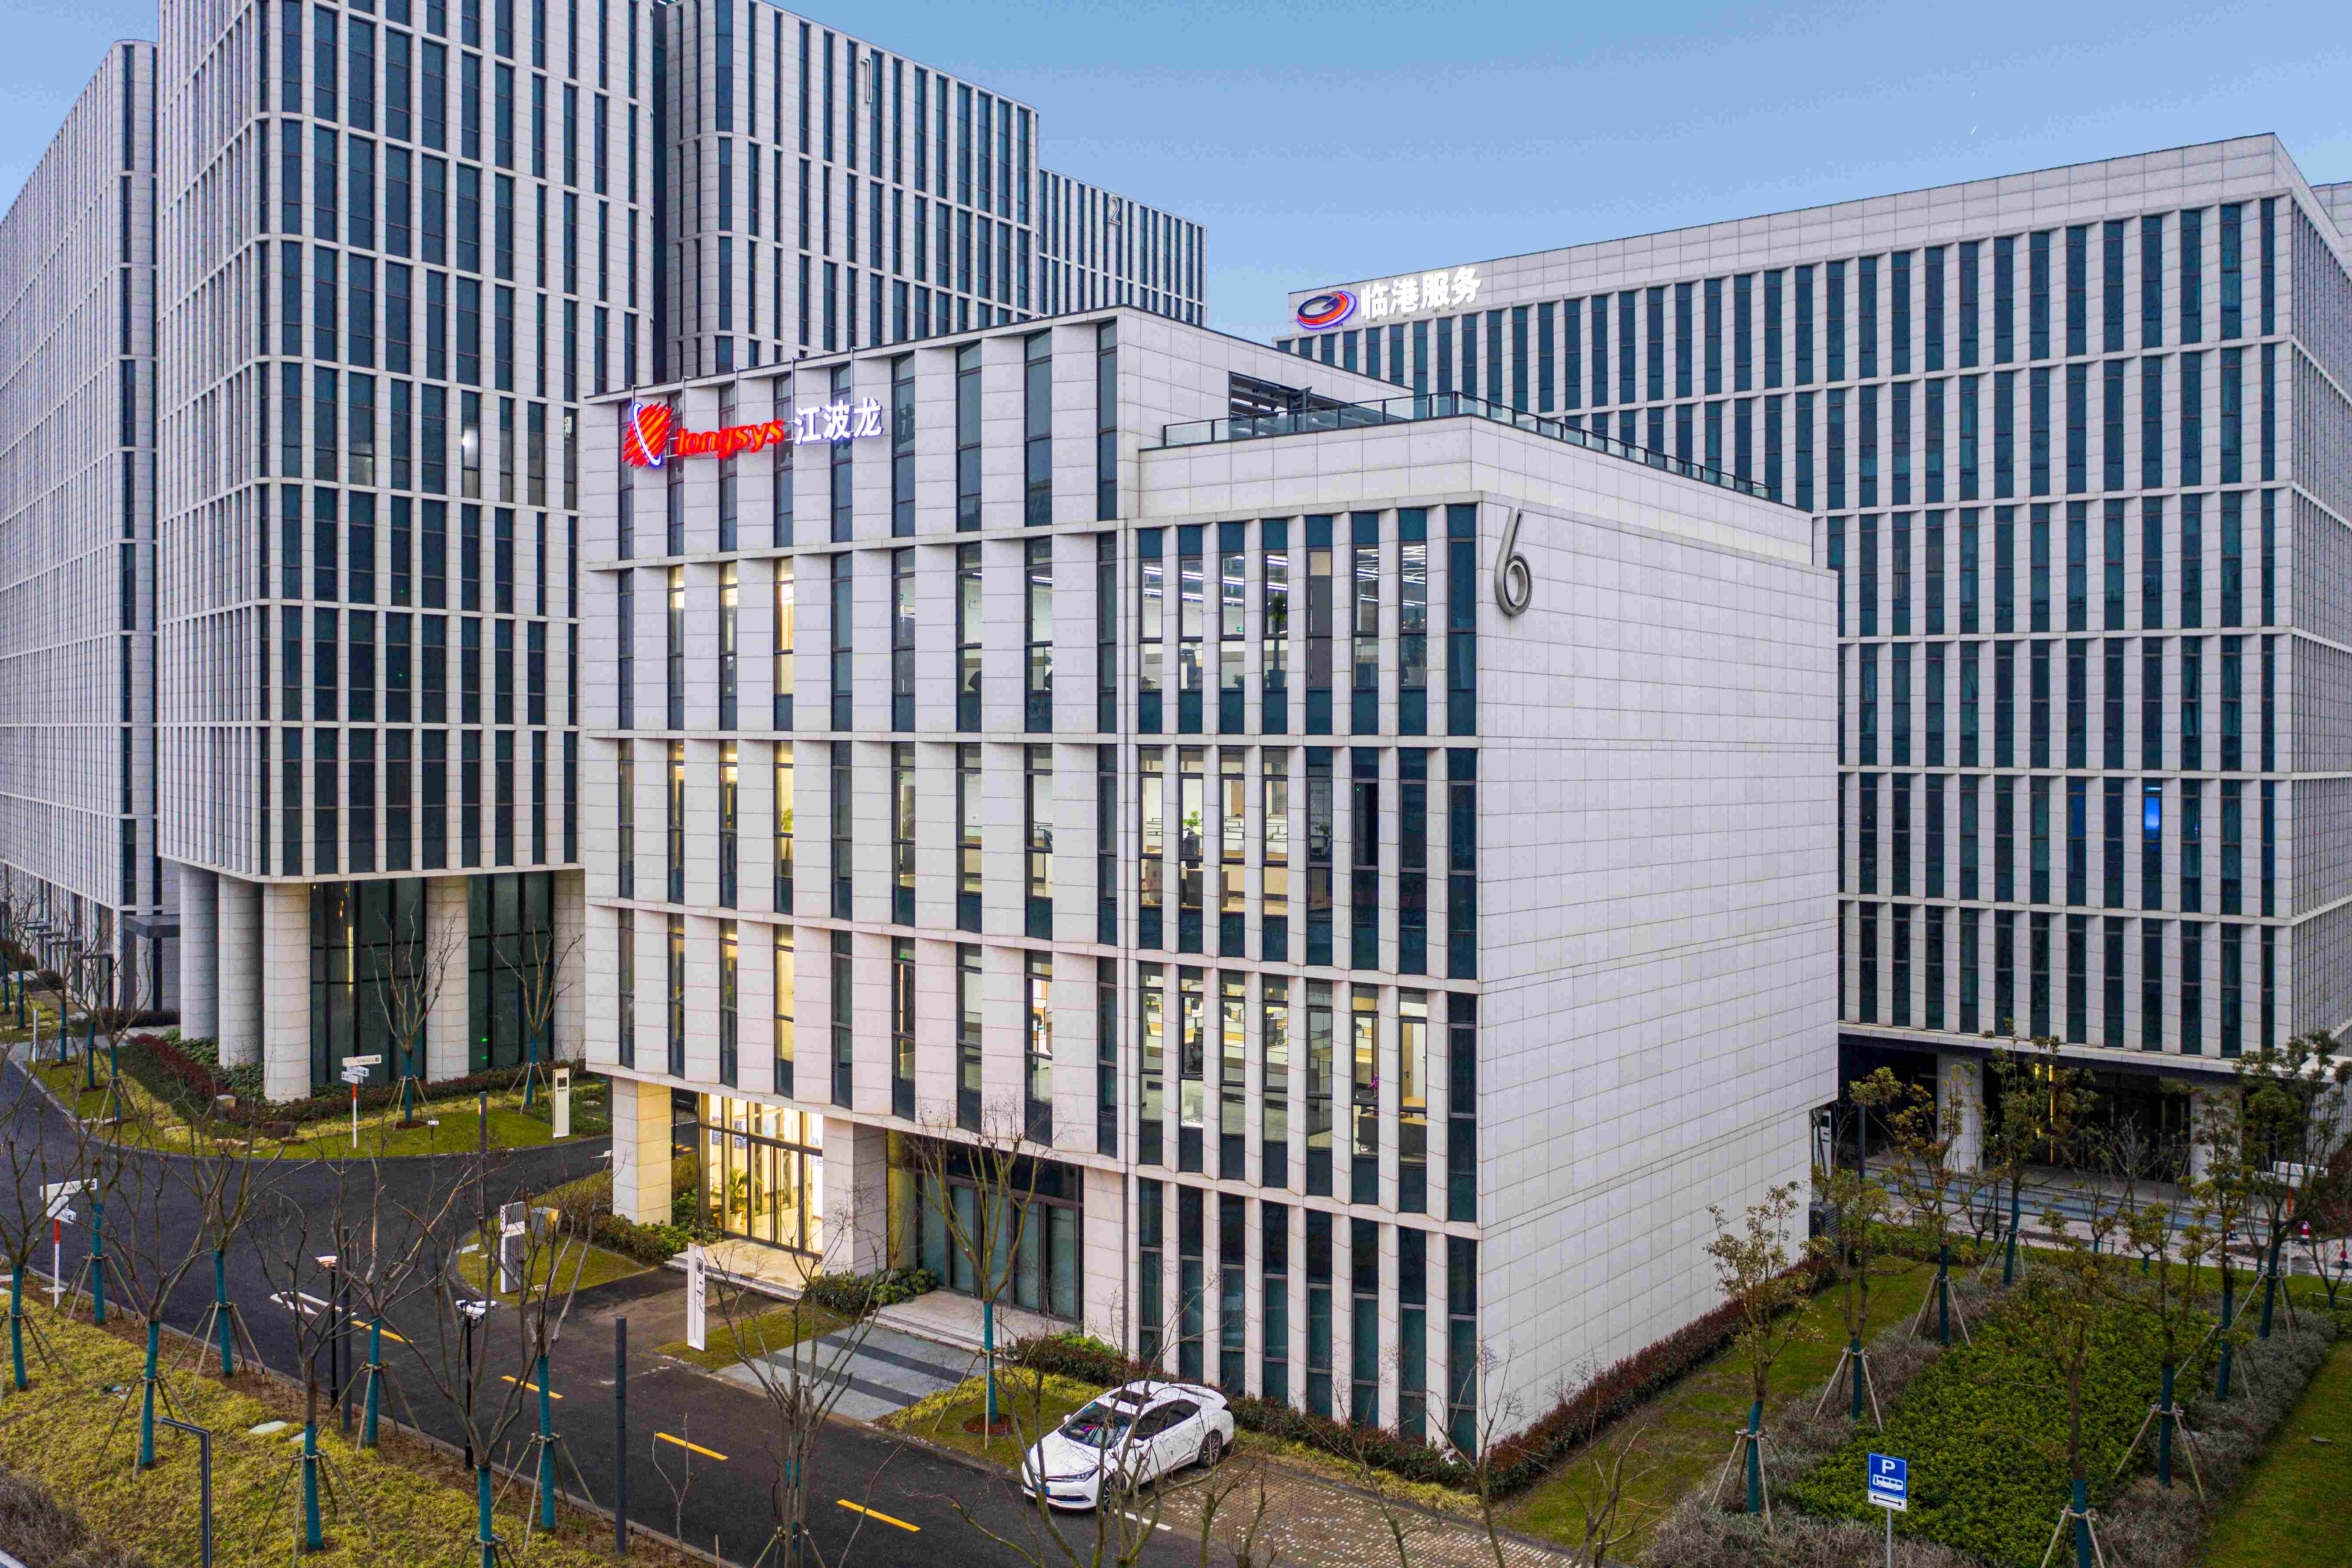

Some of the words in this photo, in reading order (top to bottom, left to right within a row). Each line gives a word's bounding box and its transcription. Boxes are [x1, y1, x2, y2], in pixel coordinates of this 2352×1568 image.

[1361, 267, 1482, 320] 临港服务
[675, 420, 785, 459] longsys
[794, 397, 885, 445] 江波龙
[1494, 507, 1532, 616] 6
[1882, 1459, 1896, 1474] P
